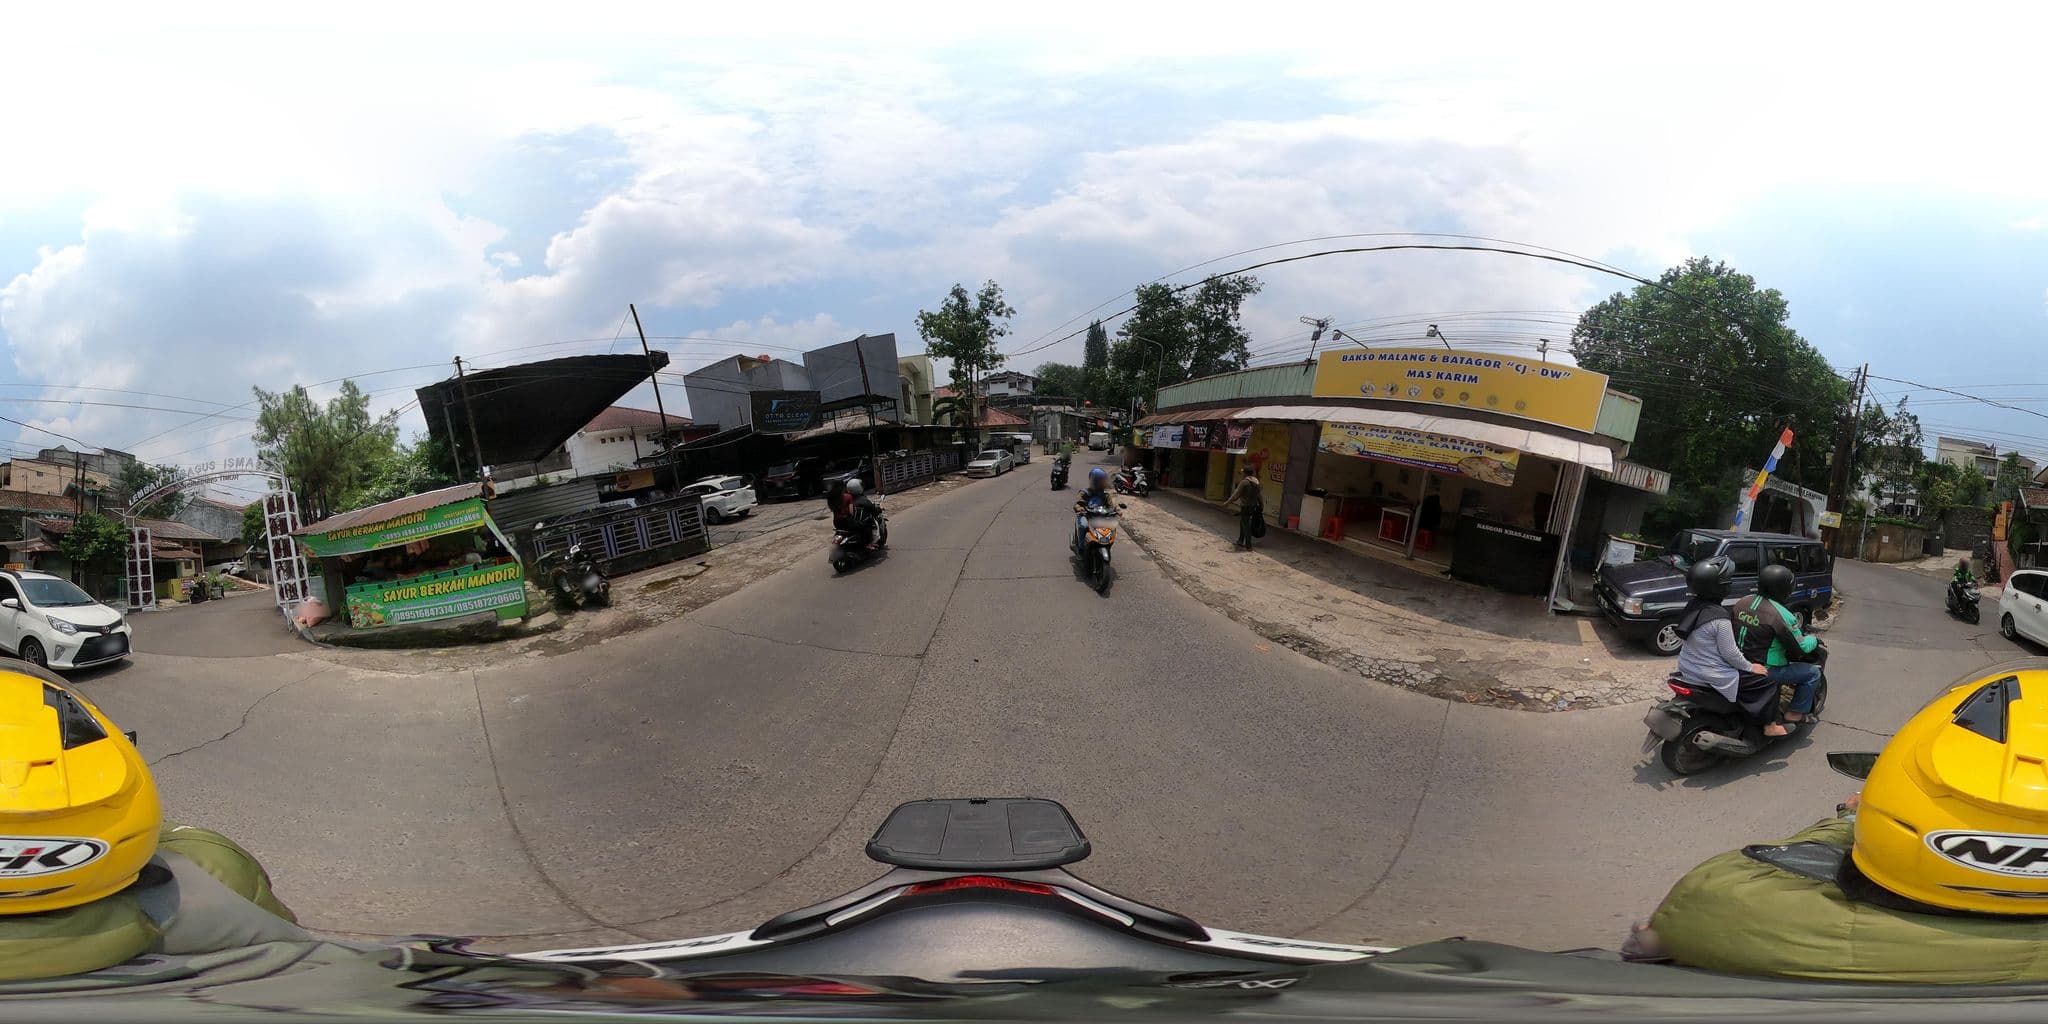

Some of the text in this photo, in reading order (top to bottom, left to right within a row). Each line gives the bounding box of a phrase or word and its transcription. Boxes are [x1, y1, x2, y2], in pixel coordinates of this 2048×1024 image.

[1341, 354, 1375, 362] BAKSO
[1378, 353, 1426, 362] MALANG
[1429, 354, 1438, 363] &
[1441, 355, 1502, 369] BATAGOR
[1406, 369, 1479, 384] MAS KARIM
[1330, 423, 1366, 432] BAKSO
[1369, 428, 1423, 439] MALANG
[1391, 435, 1425, 445] MAS
[1429, 441, 1484, 456] KARIM
[128, 475, 163, 506] LEMBAH
[328, 530, 351, 541] SAYUR
[353, 523, 385, 537] BERKAH
[387, 511, 426, 528] MANDIRI
[383, 587, 418, 603] SAYUR
[420, 578, 465, 597] BERKAH
[467, 566, 520, 588] MANDIRI
[1738, 611, 1760, 627] Grab
